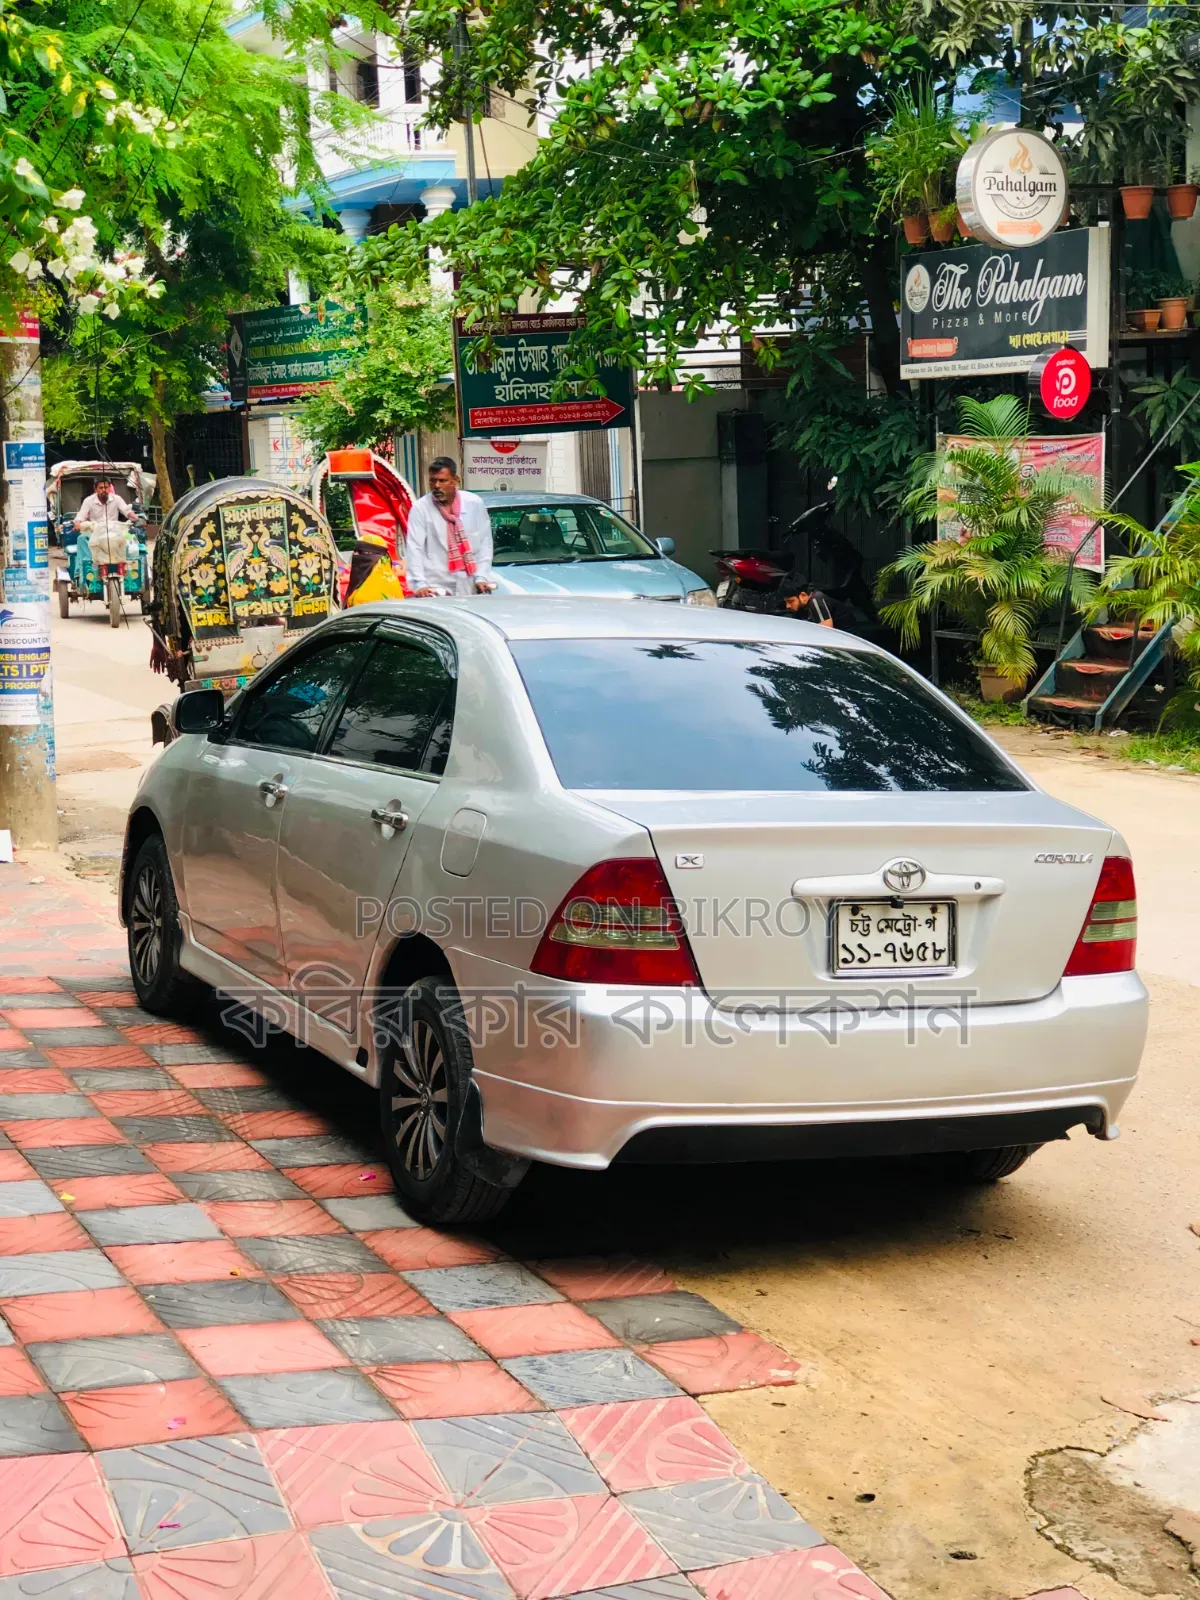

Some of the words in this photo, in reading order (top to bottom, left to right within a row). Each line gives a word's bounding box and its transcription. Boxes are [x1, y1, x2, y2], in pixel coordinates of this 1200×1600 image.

[983, 175, 1057, 197] Pahalgam
[932, 262, 972, 312] The
[976, 253, 1086, 326] Pahalgam
[932, 317, 969, 329] Pizza
[978, 314, 985, 326] &
[994, 311, 1028, 324] More
[1053, 395, 1078, 409] food
[472, 456, 504, 465] আমাদের
[506, 454, 538, 465] প্রতিষ্ঠানে
[467, 467, 515, 475] আপনাদেরকে
[4, 637, 41, 645] DISCOUNT
[19, 652, 50, 661] ENGLISH
[1034, 852, 1093, 865] COROLLA
[841, 942, 946, 964] ১১-৭৬৫৮
